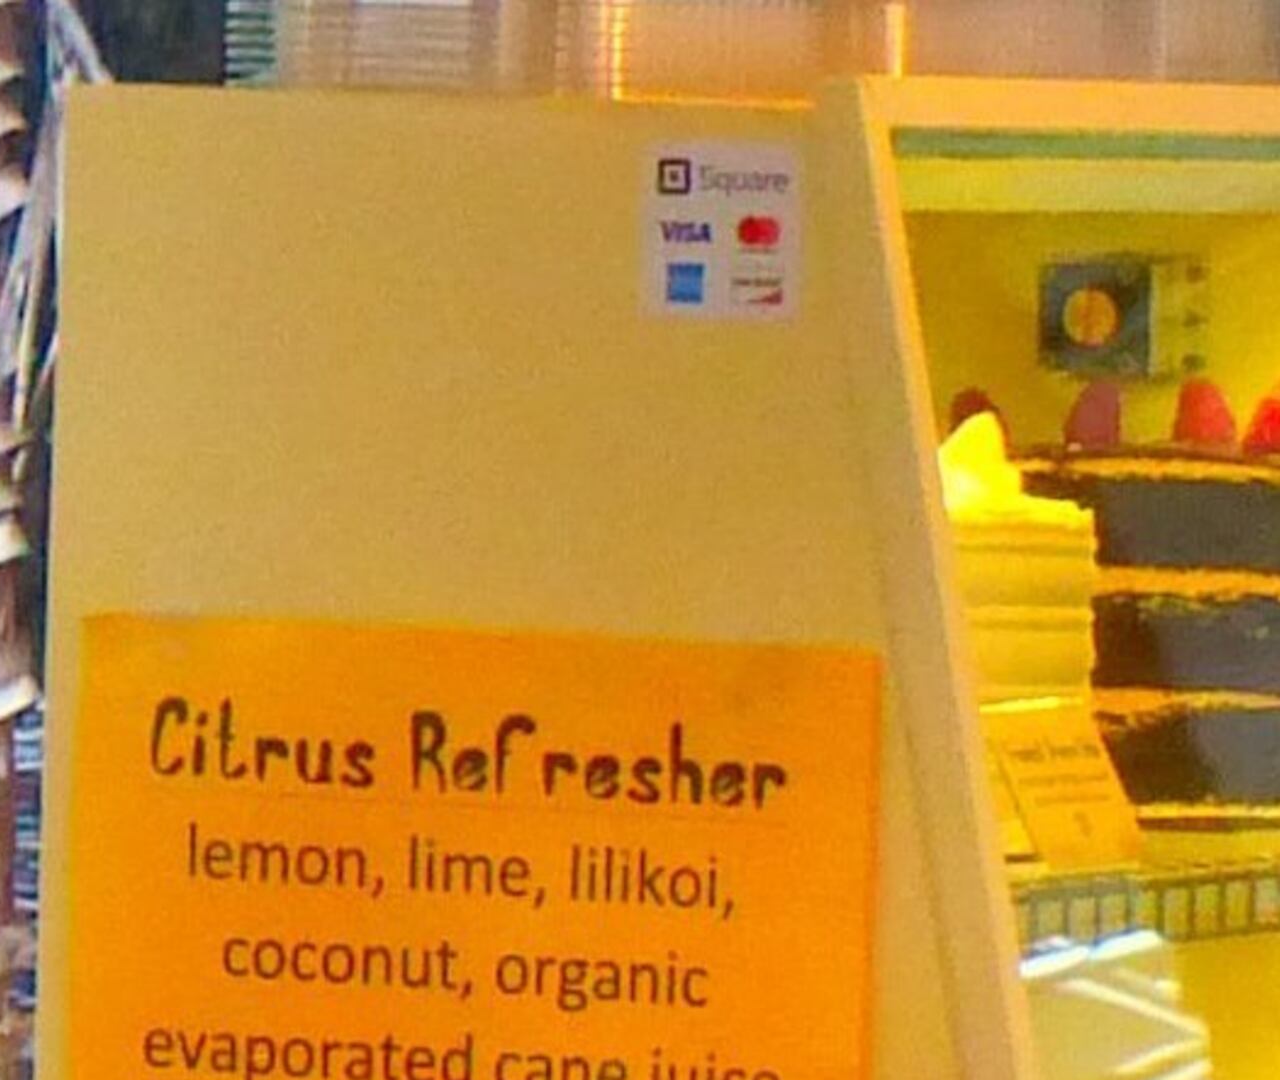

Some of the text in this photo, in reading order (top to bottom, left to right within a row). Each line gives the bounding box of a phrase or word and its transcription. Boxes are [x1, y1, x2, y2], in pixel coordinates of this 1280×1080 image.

[700, 165, 790, 196] Square
[660, 221, 712, 243] VISA
[151, 696, 787, 810] Citrus Refresher
[189, 821, 734, 921] lemon, lime, lilikoi,
[222, 938, 709, 1012] coconut, organic
